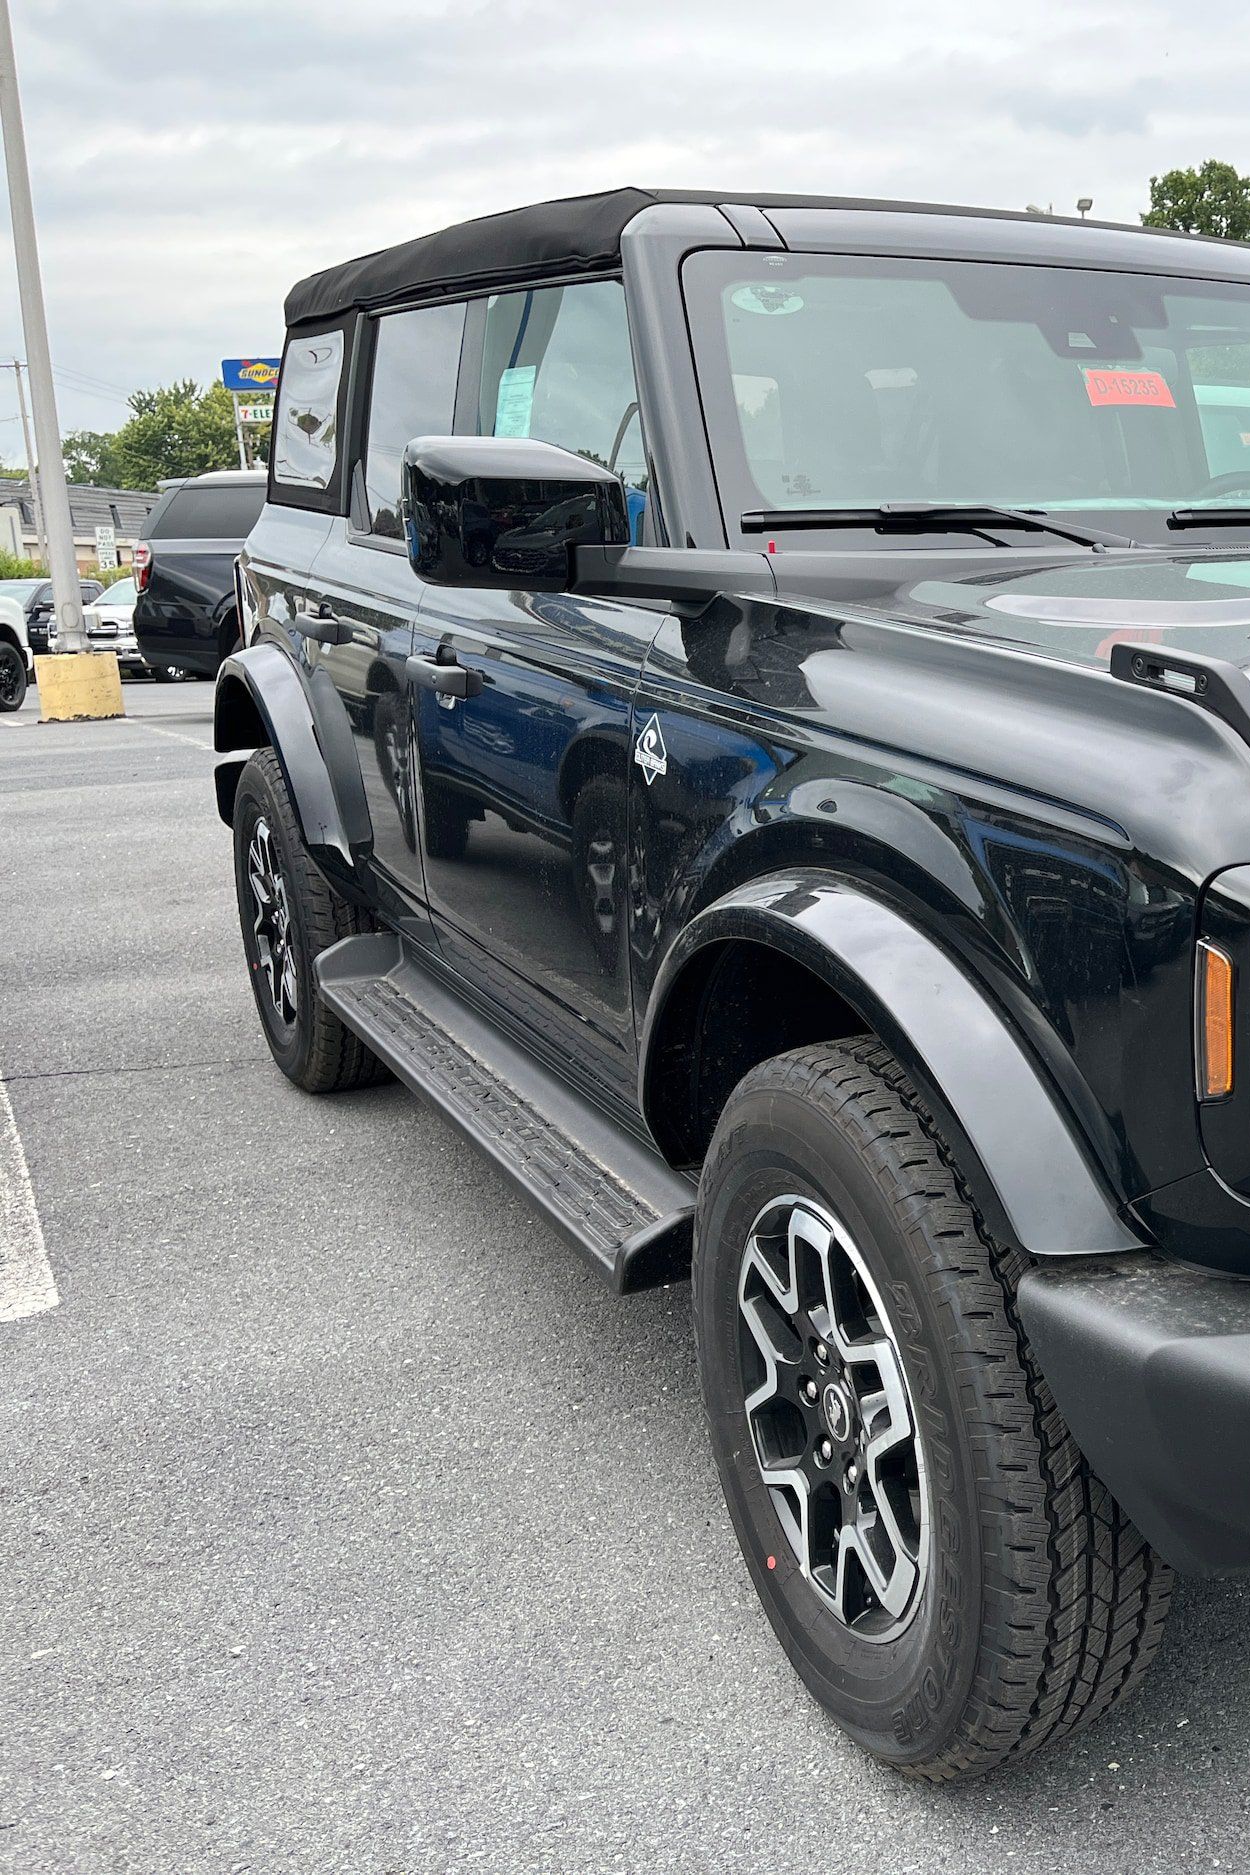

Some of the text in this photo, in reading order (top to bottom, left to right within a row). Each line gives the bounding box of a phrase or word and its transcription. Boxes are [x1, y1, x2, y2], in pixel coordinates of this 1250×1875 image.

[1093, 377, 1160, 396] D-15235
[241, 409, 272, 419] 7-ELE
[101, 560, 116, 569] 35
[425, 1043, 540, 1145] BRONCO
[884, 1279, 963, 1746] BRIDGESTONE
